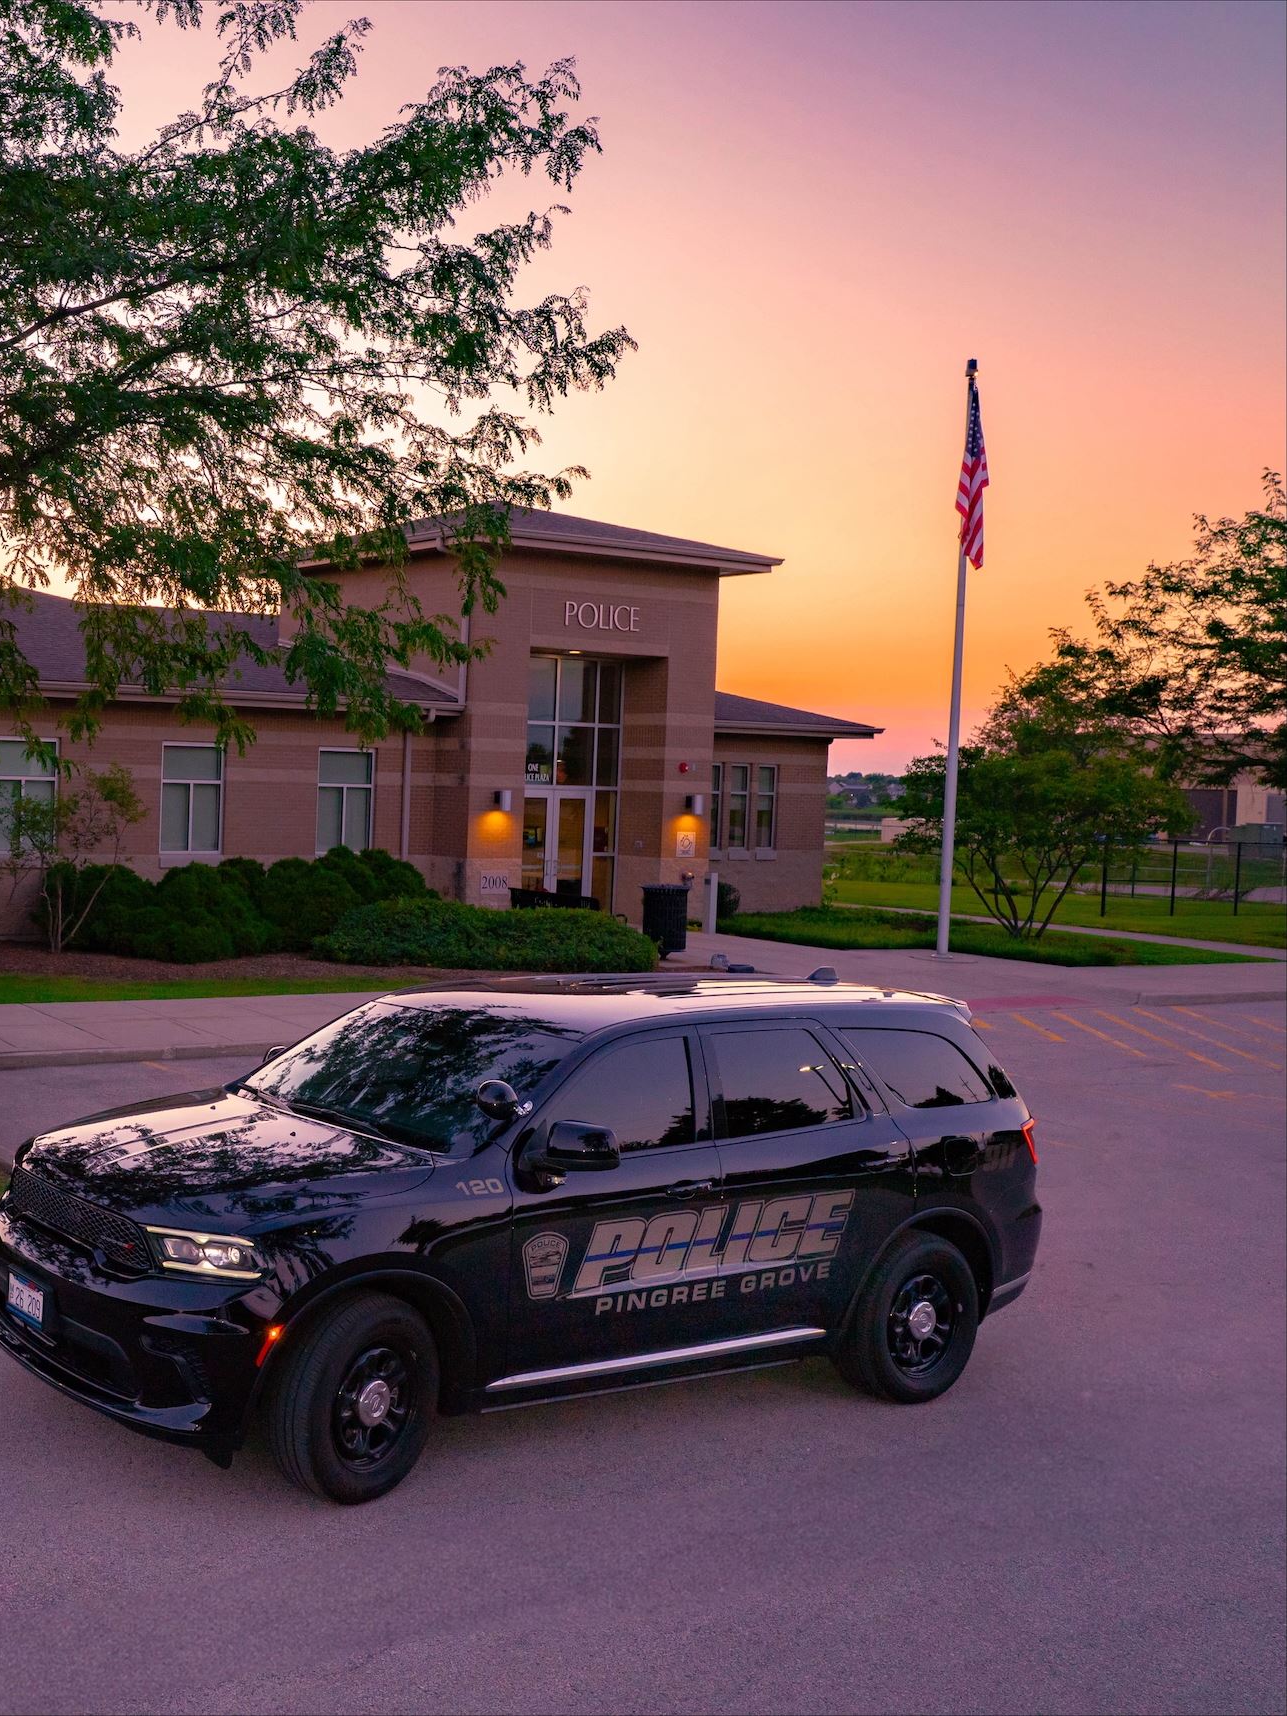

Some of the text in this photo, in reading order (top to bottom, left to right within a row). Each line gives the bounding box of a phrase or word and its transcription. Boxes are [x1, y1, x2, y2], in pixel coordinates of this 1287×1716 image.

[564, 601, 640, 632] POLICE
[527, 763, 539, 771] ONE
[534, 773, 550, 781] PLAZA
[481, 875, 508, 889] 2008
[456, 1178, 504, 1195] 120
[531, 1239, 562, 1251] POLICE
[572, 1189, 855, 1297] POLICE
[595, 1261, 832, 1316] PINGREE GROVE
[15, 1286, 24, 1309] 26
[27, 1294, 41, 1319] 209
